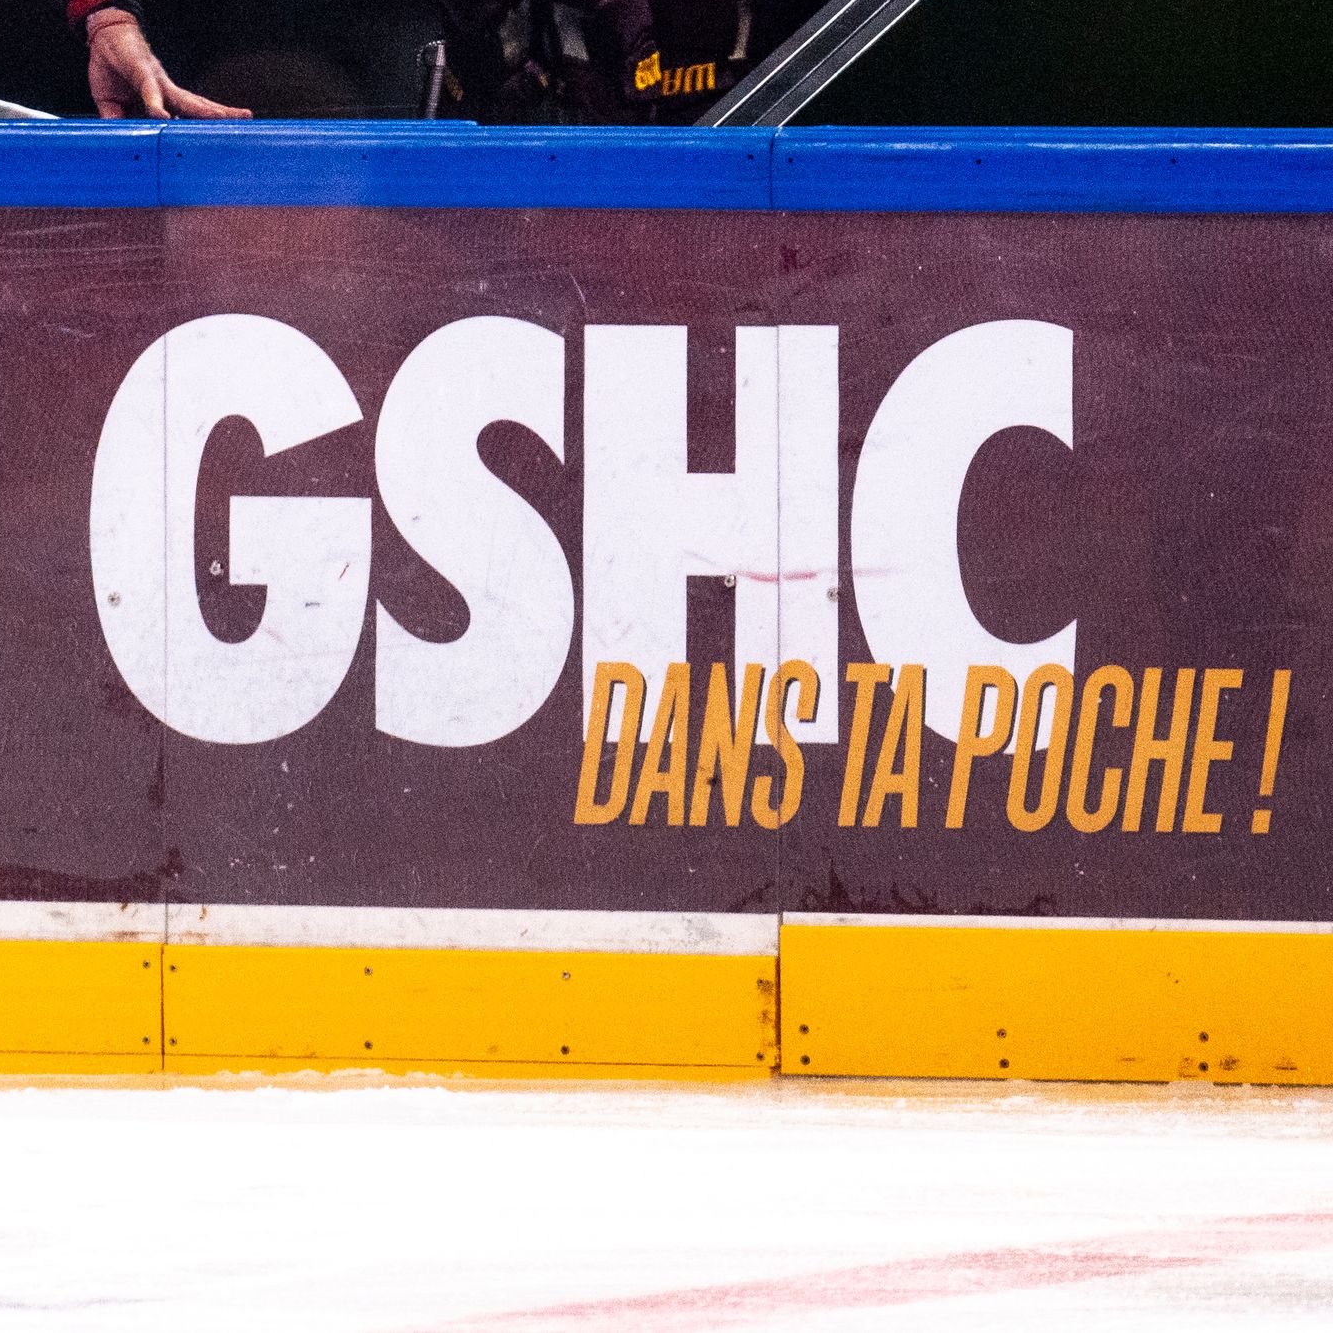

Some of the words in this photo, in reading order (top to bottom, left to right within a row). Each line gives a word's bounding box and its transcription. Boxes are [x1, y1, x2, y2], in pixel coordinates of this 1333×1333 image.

[90, 313, 1077, 751] GSHC
[573, 658, 822, 830] DANS
[837, 662, 927, 829] TA
[944, 662, 1243, 834] POCHE
